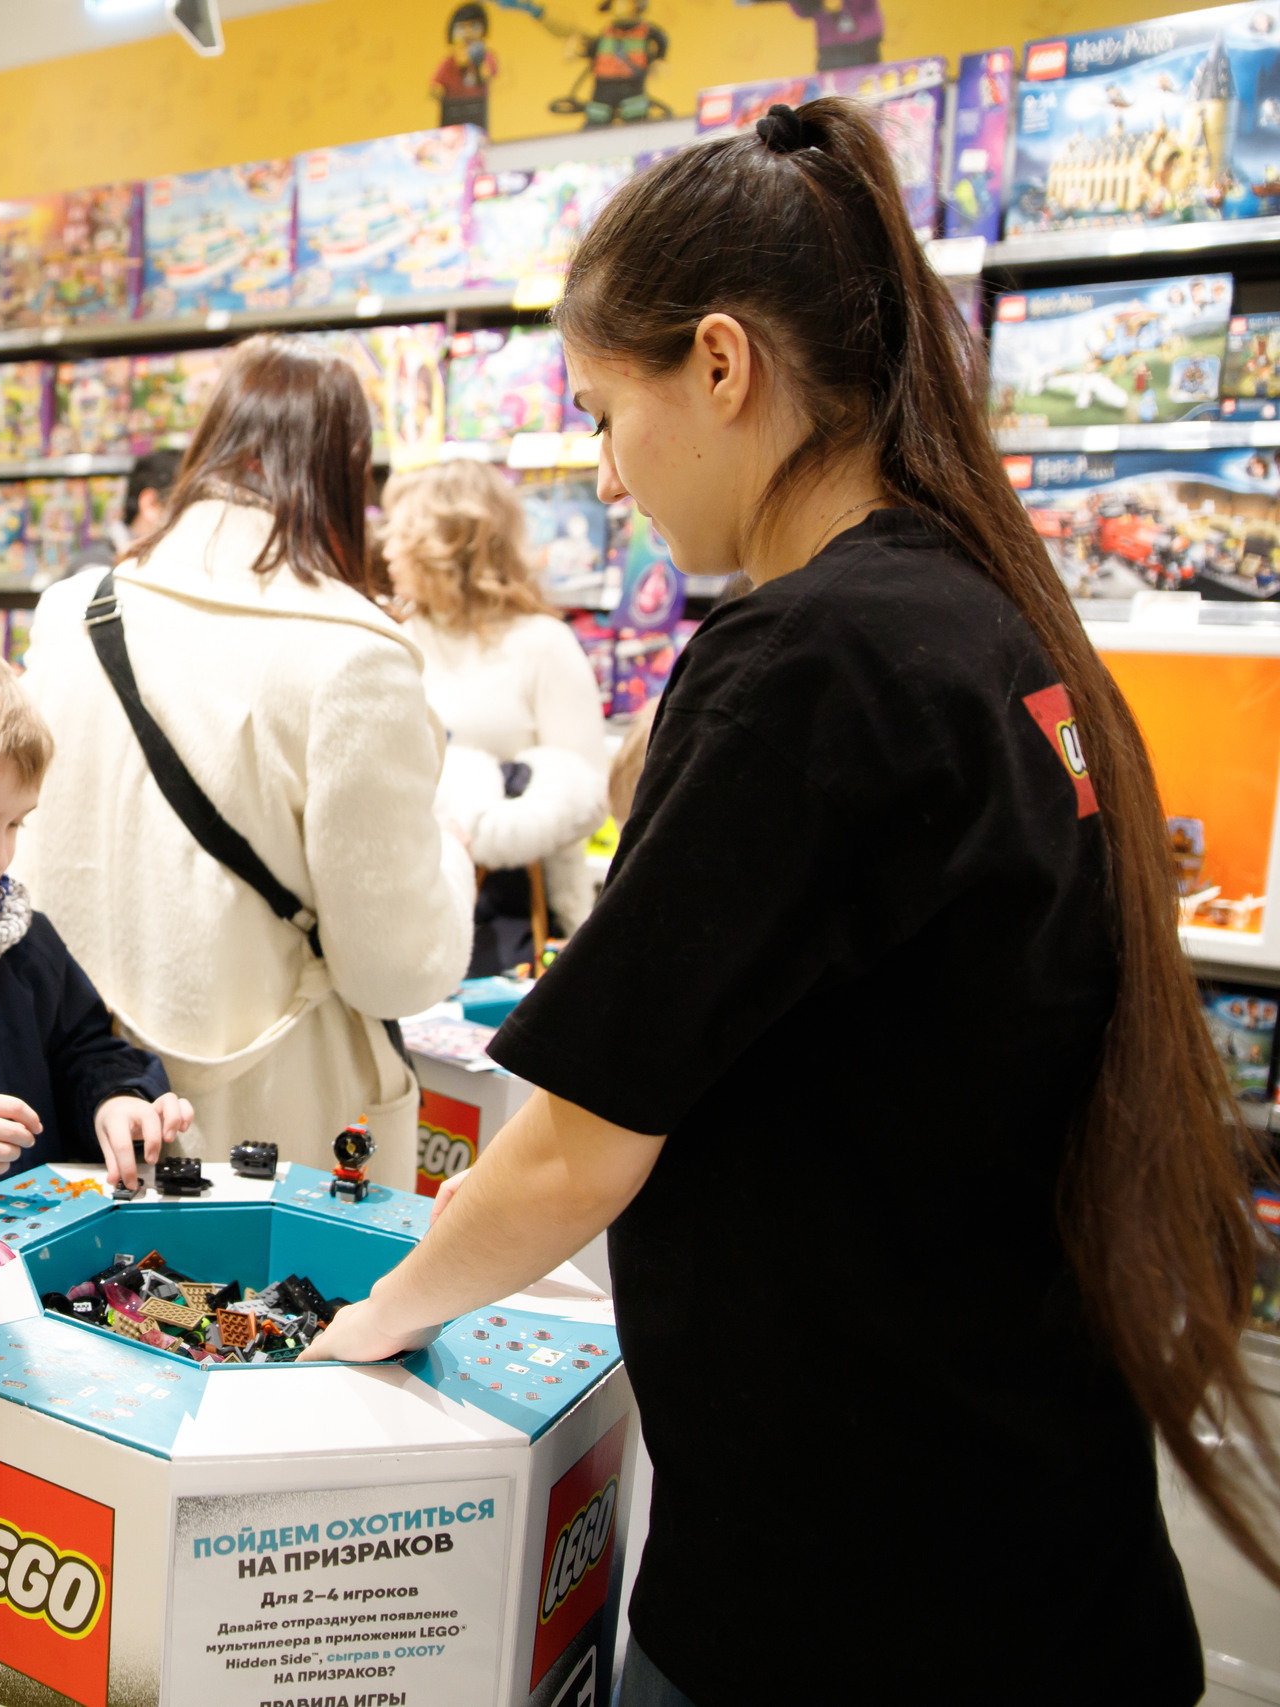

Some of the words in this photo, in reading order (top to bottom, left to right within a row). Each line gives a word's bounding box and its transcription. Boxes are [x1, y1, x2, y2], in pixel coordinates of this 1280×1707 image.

[417, 1126, 471, 1178] EGO
[193, 1523, 320, 1559] ПОЙДЕМ
[325, 1498, 495, 1542] ОХОТИТЬСЯ
[238, 1556, 278, 1579] НА
[284, 1532, 454, 1573] ПРИЗРАКОВ
[543, 1481, 618, 1619] LEGO
[260, 1591, 298, 1609] Для
[343, 1586, 419, 1603] игроков
[217, 1619, 278, 1636] Давайте
[281, 1613, 377, 1630] отпразднуем
[379, 1609, 458, 1622] появление
[205, 1636, 311, 1655] мультиплеера
[314, 1636, 322, 1645] в
[325, 1630, 416, 1647] приложении
[225, 1656, 277, 1670] Hidden
[326, 1651, 380, 1664] сыграв
[382, 1650, 391, 1659] в
[394, 1645, 446, 1659] ОХОТУ
[273, 1672, 294, 1684] НА
[297, 1666, 396, 1683] ПРИЗРАКОВ?
[353, 1692, 407, 1707] ИГРЫ
